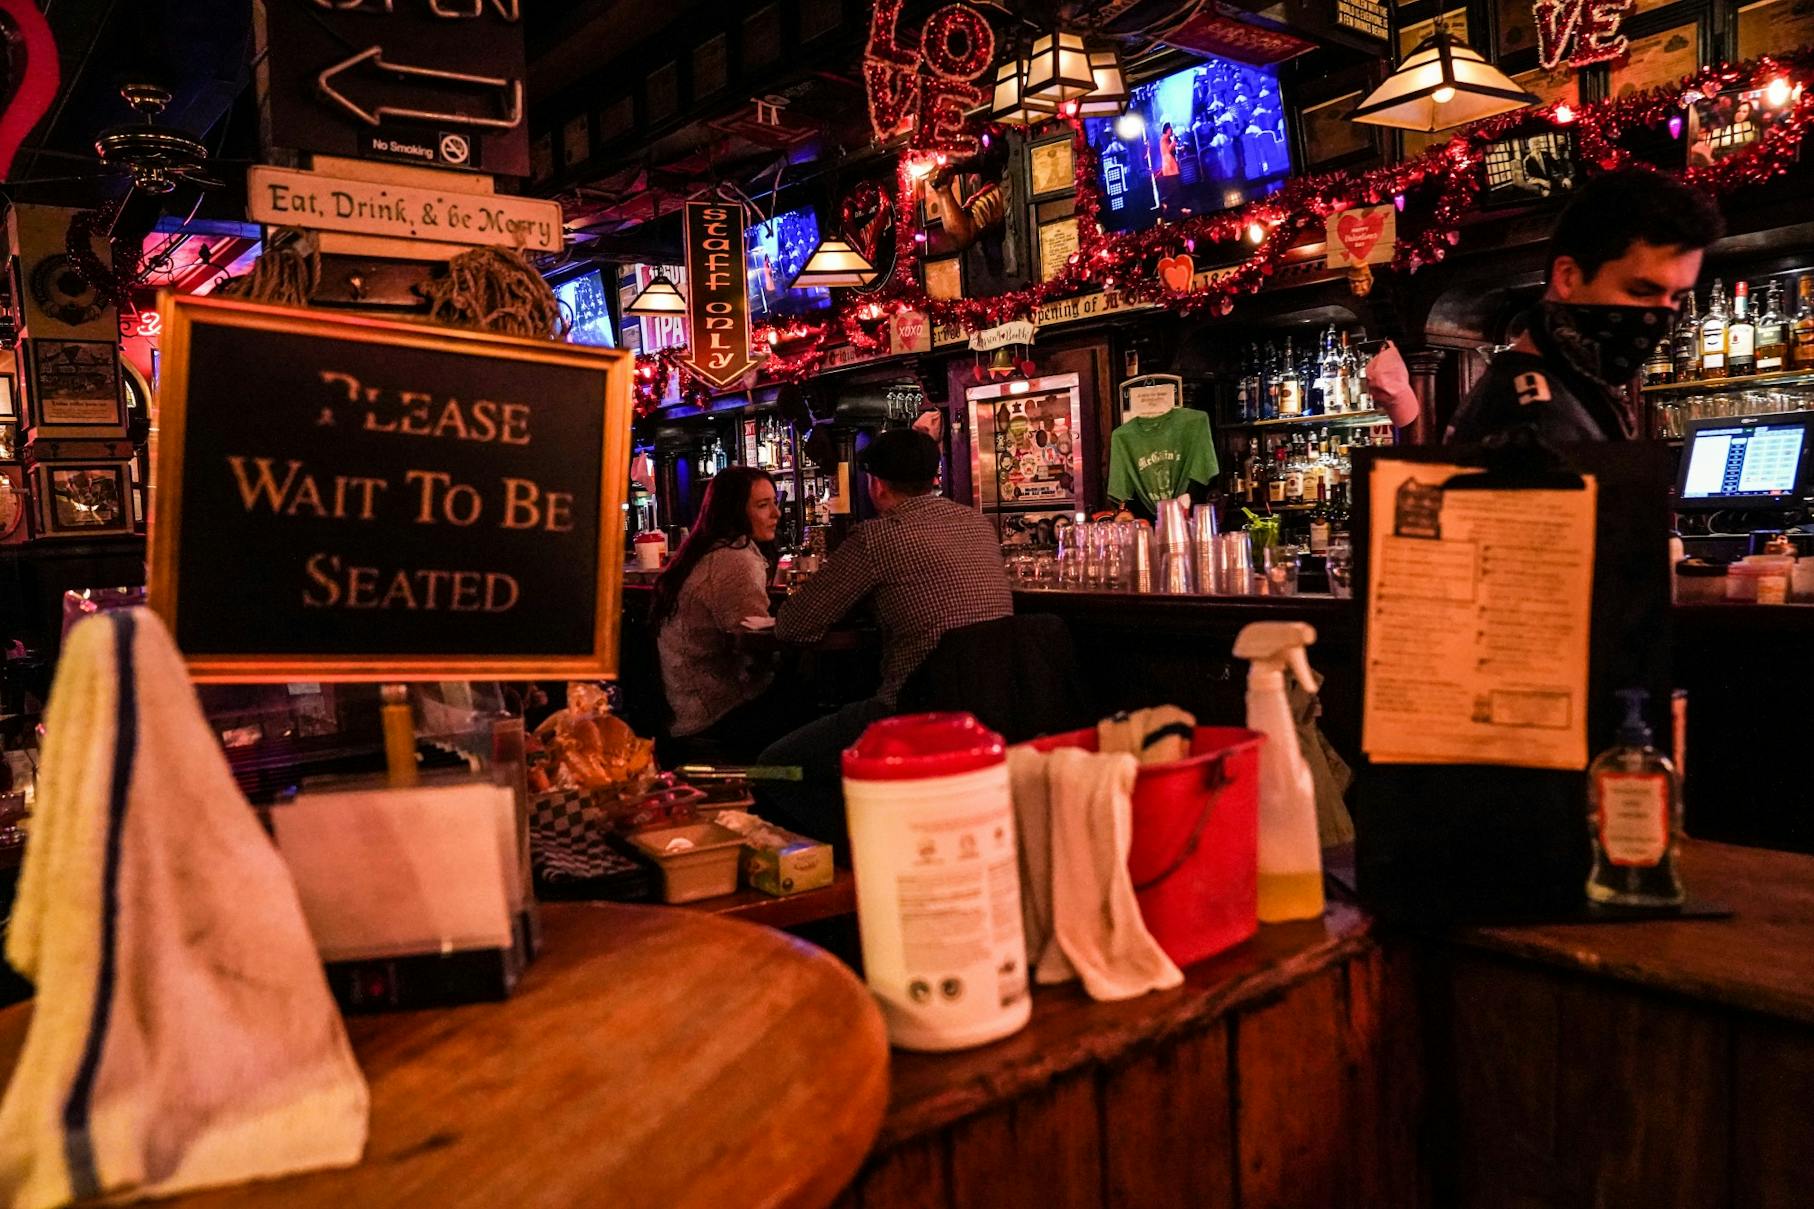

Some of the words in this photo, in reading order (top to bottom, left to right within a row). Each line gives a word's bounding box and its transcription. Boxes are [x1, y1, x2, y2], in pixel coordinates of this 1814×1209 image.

[373, 138, 388, 150] No
[389, 140, 434, 159] Smoking
[267, 183, 325, 218] Eat,
[331, 191, 414, 226] Drink,
[422, 203, 438, 225] &
[448, 205, 471, 228] be
[1083, 296, 1097, 313] of
[655, 315, 685, 348] IPA
[899, 324, 923, 338] XOXO
[1513, 371, 1552, 405] 9
[226, 455, 388, 521] WAIT
[405, 468, 482, 527] TO
[501, 477, 575, 533] BE
[302, 552, 520, 613] SEATED
